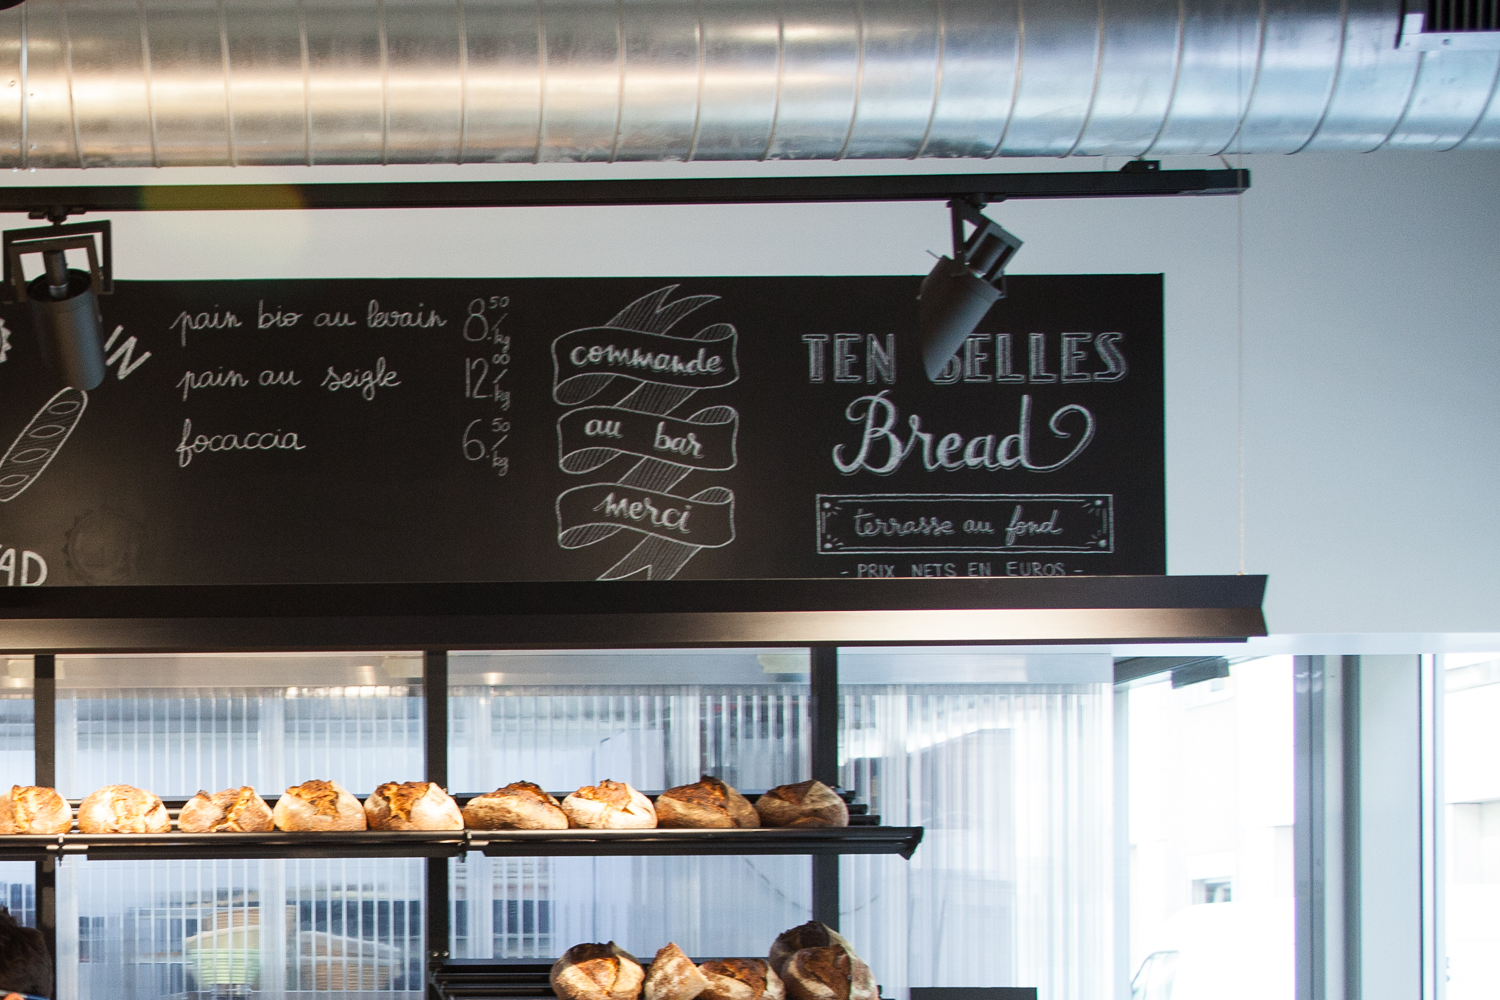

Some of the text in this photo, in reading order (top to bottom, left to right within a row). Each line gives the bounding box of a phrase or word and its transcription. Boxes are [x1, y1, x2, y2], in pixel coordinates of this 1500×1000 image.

[169, 304, 242, 347] pain
[258, 299, 303, 330] bio
[313, 310, 357, 327] au
[366, 299, 448, 329] levain
[176, 366, 249, 402] pain
[258, 369, 302, 387] au
[320, 356, 402, 401] seigle
[569, 343, 725, 376] commande
[801, 332, 897, 385] TEN
[175, 418, 306, 468] focaccia
[583, 417, 705, 459] au bar
[831, 389, 1096, 477] Bread
[853, 504, 1064, 547] terrasse au fond
[856, 562, 896, 578] PRIX
[911, 562, 958, 577] NETS
[967, 561, 992, 577] EN
[1005, 561, 1067, 577] EUROS
